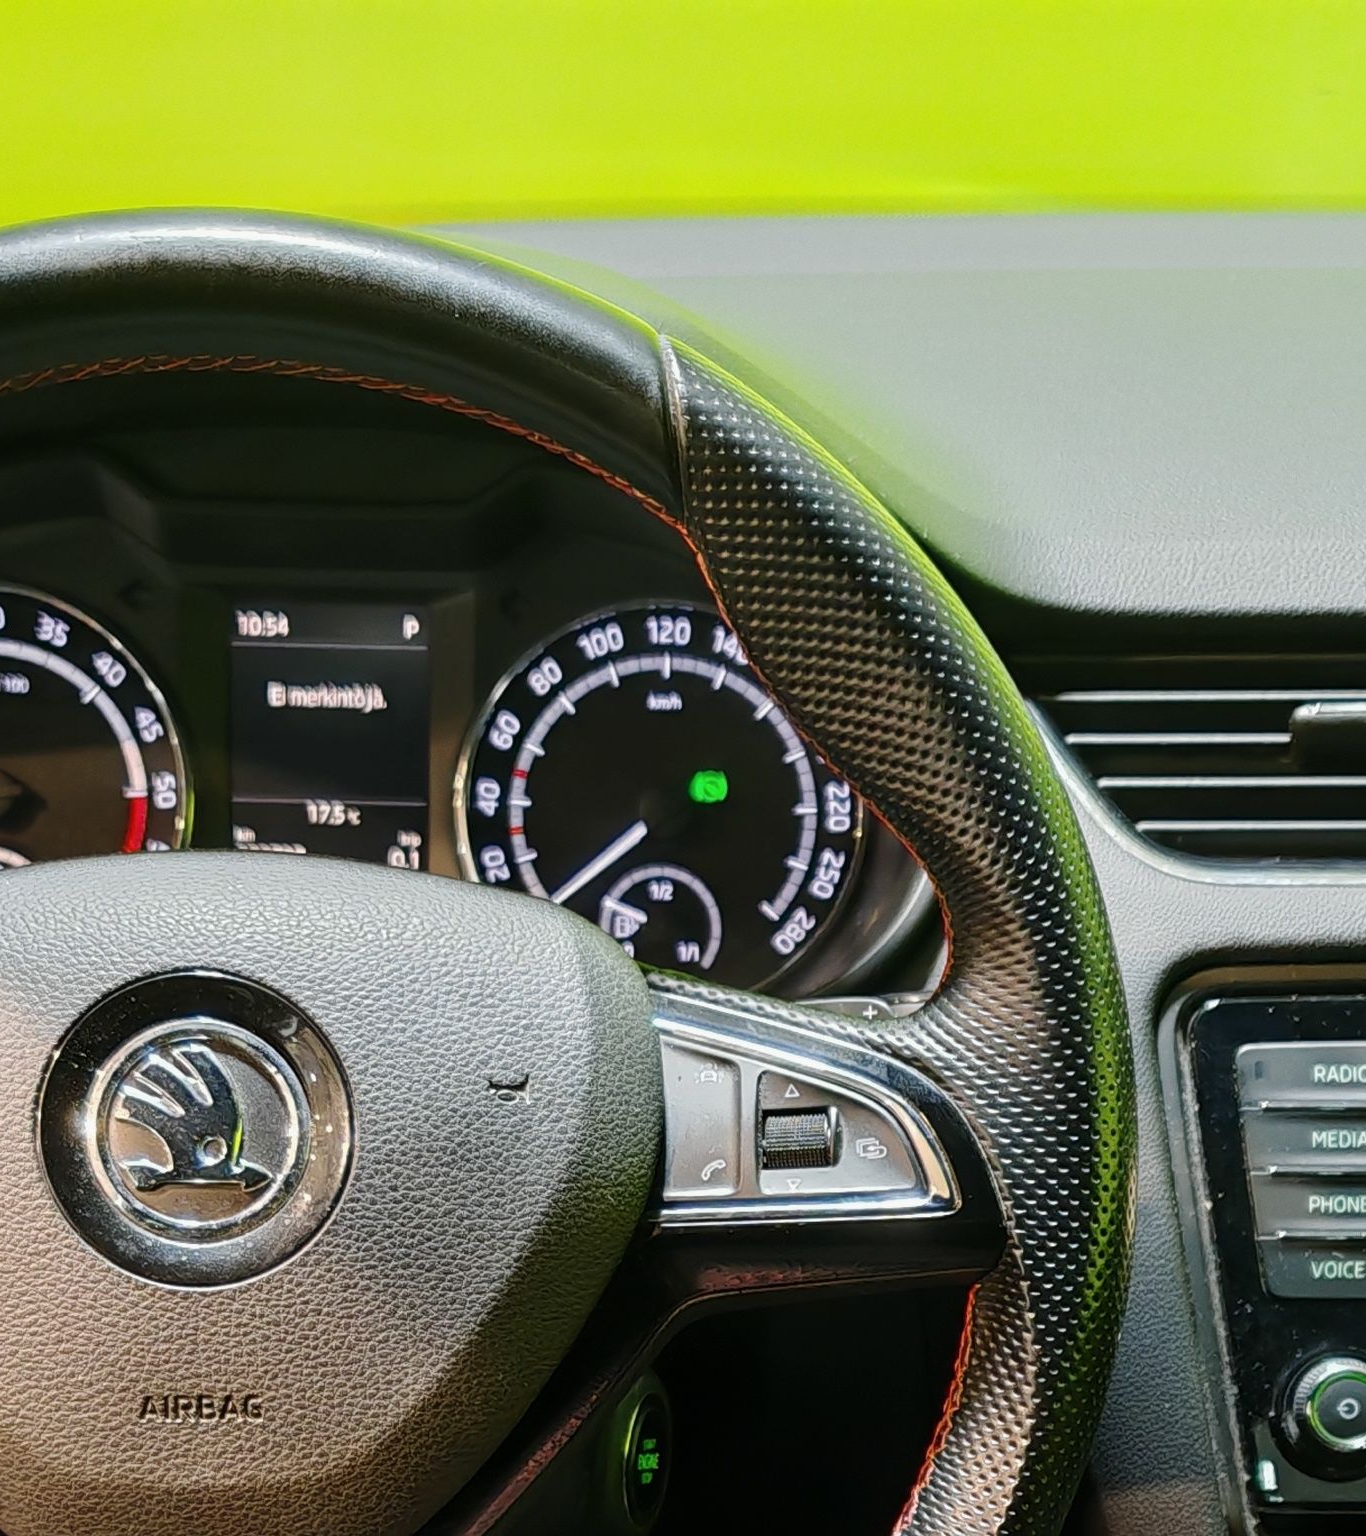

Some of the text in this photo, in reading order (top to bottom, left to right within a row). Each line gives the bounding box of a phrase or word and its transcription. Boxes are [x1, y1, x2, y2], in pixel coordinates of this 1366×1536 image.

[34, 610, 70, 646] 35
[576, 622, 625, 660] 100
[645, 616, 692, 646] 120
[90, 651, 126, 688] 40
[526, 657, 563, 696] 80
[646, 690, 683, 711] km/h
[136, 706, 164, 742] 45
[488, 711, 521, 751] 60
[151, 771, 176, 810] 50
[475, 777, 501, 817] 40
[823, 780, 851, 834] 220
[479, 846, 511, 884] 20
[808, 848, 846, 899] 250
[648, 880, 674, 901] 1/2
[770, 907, 816, 956] 280
[1311, 1260, 1366, 1279] VOICE
[137, 1394, 264, 1423] AIRBAG
